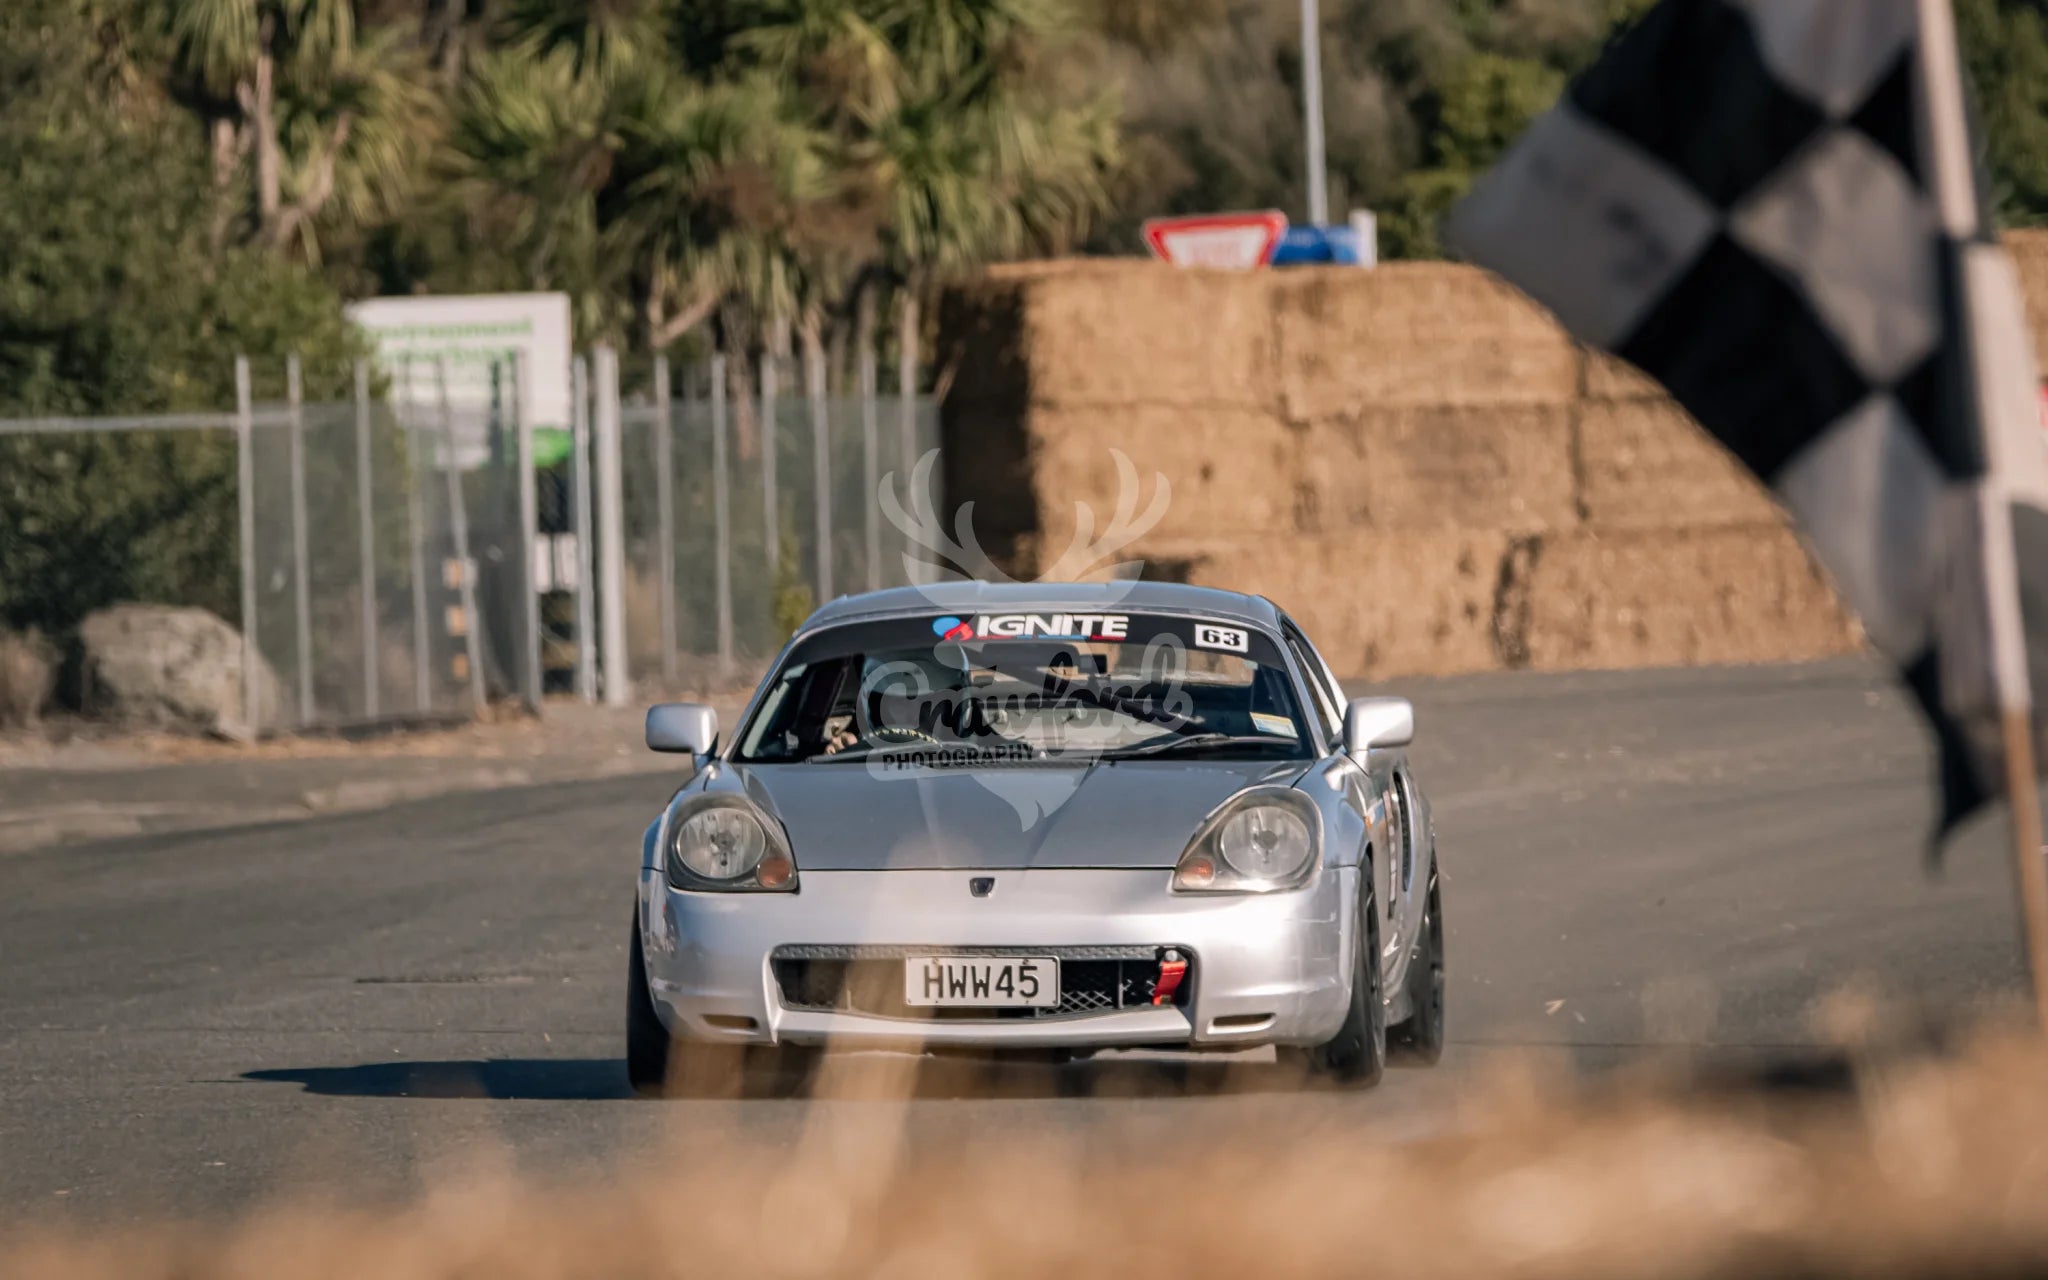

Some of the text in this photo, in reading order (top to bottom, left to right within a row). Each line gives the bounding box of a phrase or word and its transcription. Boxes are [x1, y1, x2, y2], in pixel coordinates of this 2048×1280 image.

[977, 614, 1129, 637] IGNITE
[1203, 629, 1240, 646] 63
[923, 965, 1040, 998] HWW45
